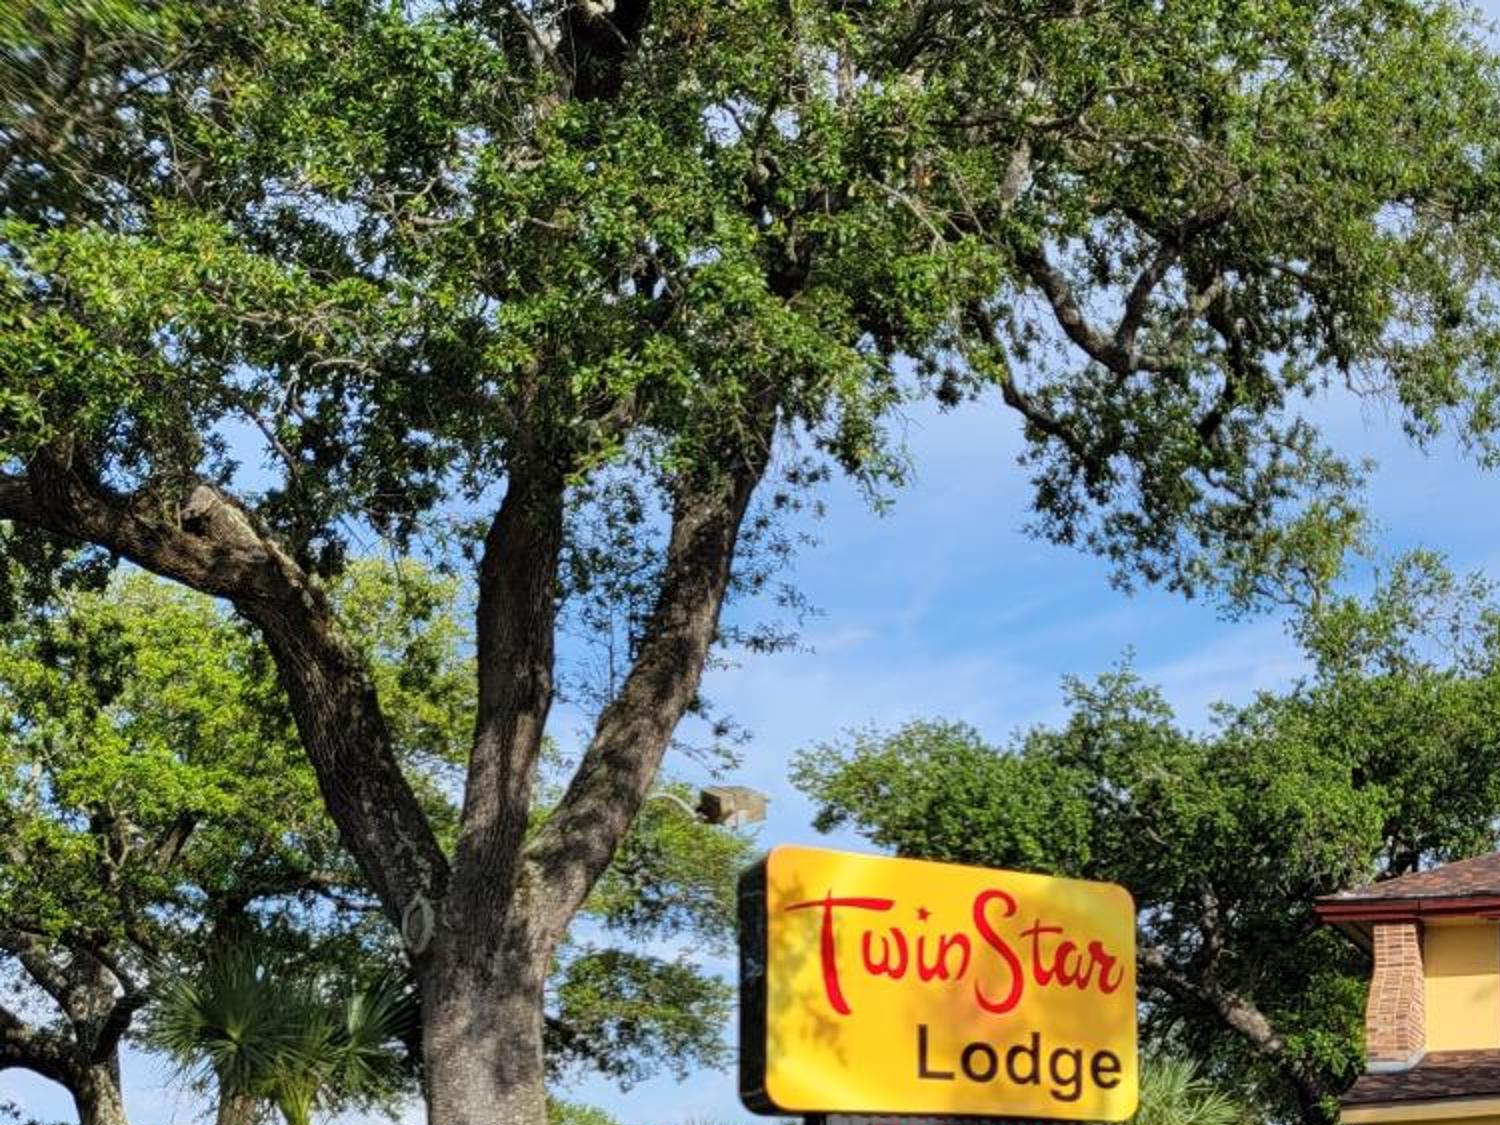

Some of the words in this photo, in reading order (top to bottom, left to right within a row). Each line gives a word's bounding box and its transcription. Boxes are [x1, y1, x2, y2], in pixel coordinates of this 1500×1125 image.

[785, 888, 972, 1016] Twin
[972, 888, 1124, 1015] Star
[917, 1024, 1122, 1102] Lodge
